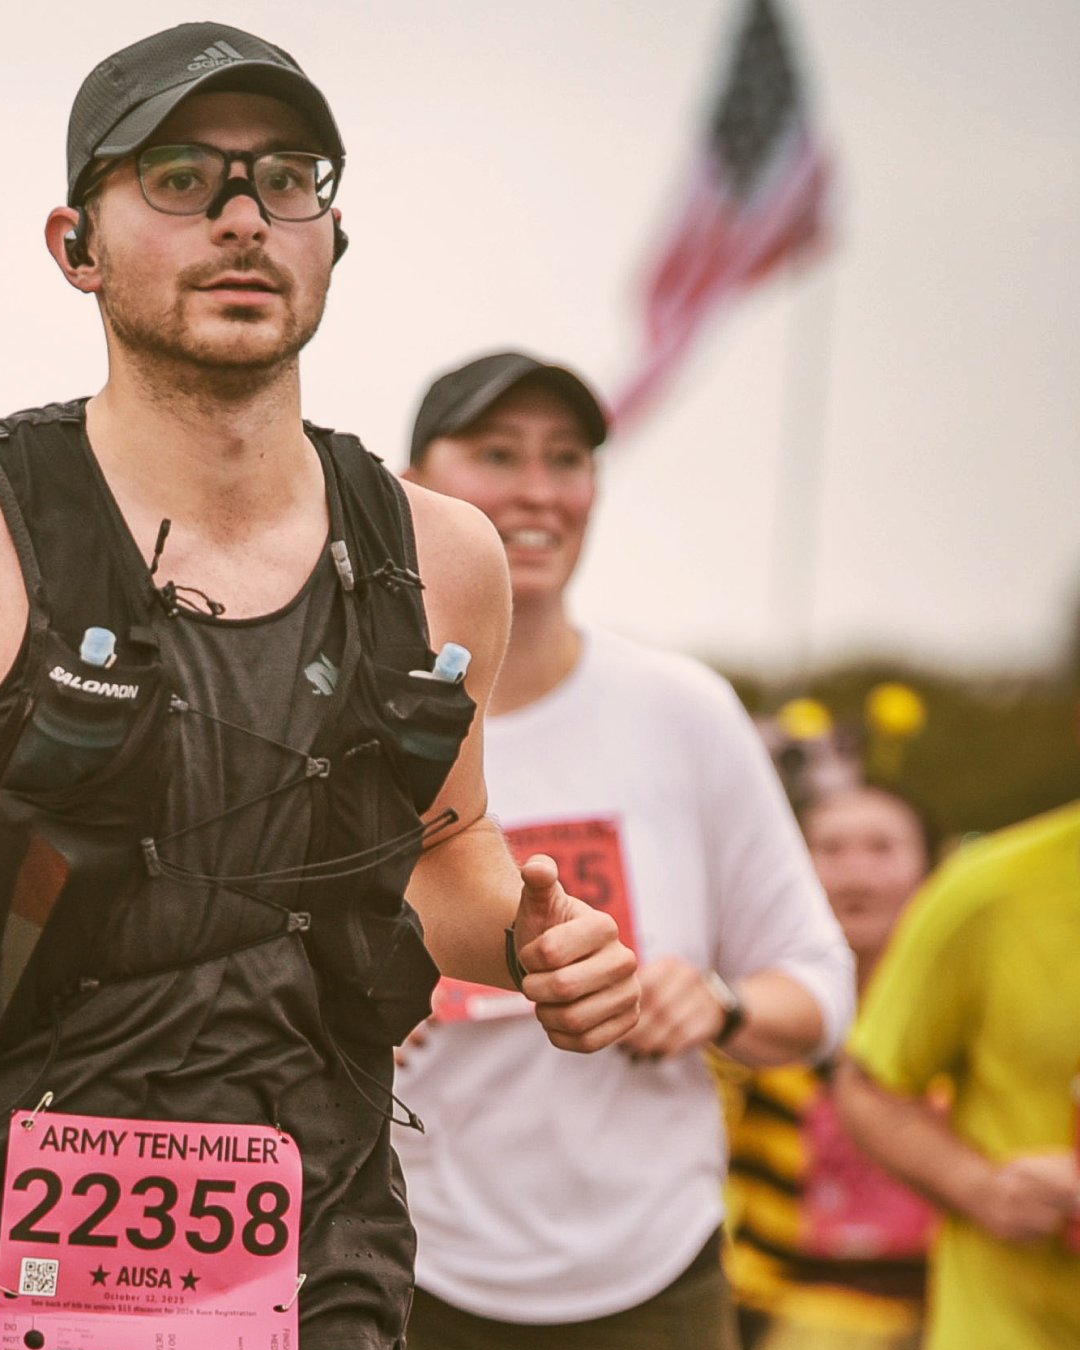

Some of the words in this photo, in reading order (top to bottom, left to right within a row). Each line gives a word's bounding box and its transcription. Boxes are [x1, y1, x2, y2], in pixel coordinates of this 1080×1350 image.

[49, 666, 139, 699] SALOMON
[39, 1125, 127, 1156] ARMY
[134, 1131, 279, 1164] TEN-MILER
[8, 1167, 291, 1257] 22358
[116, 1266, 172, 1290] AUSA
[104, 1292, 140, 1301] October
[215, 1308, 257, 1317] Registration
[3, 1322, 17, 1331] DO
